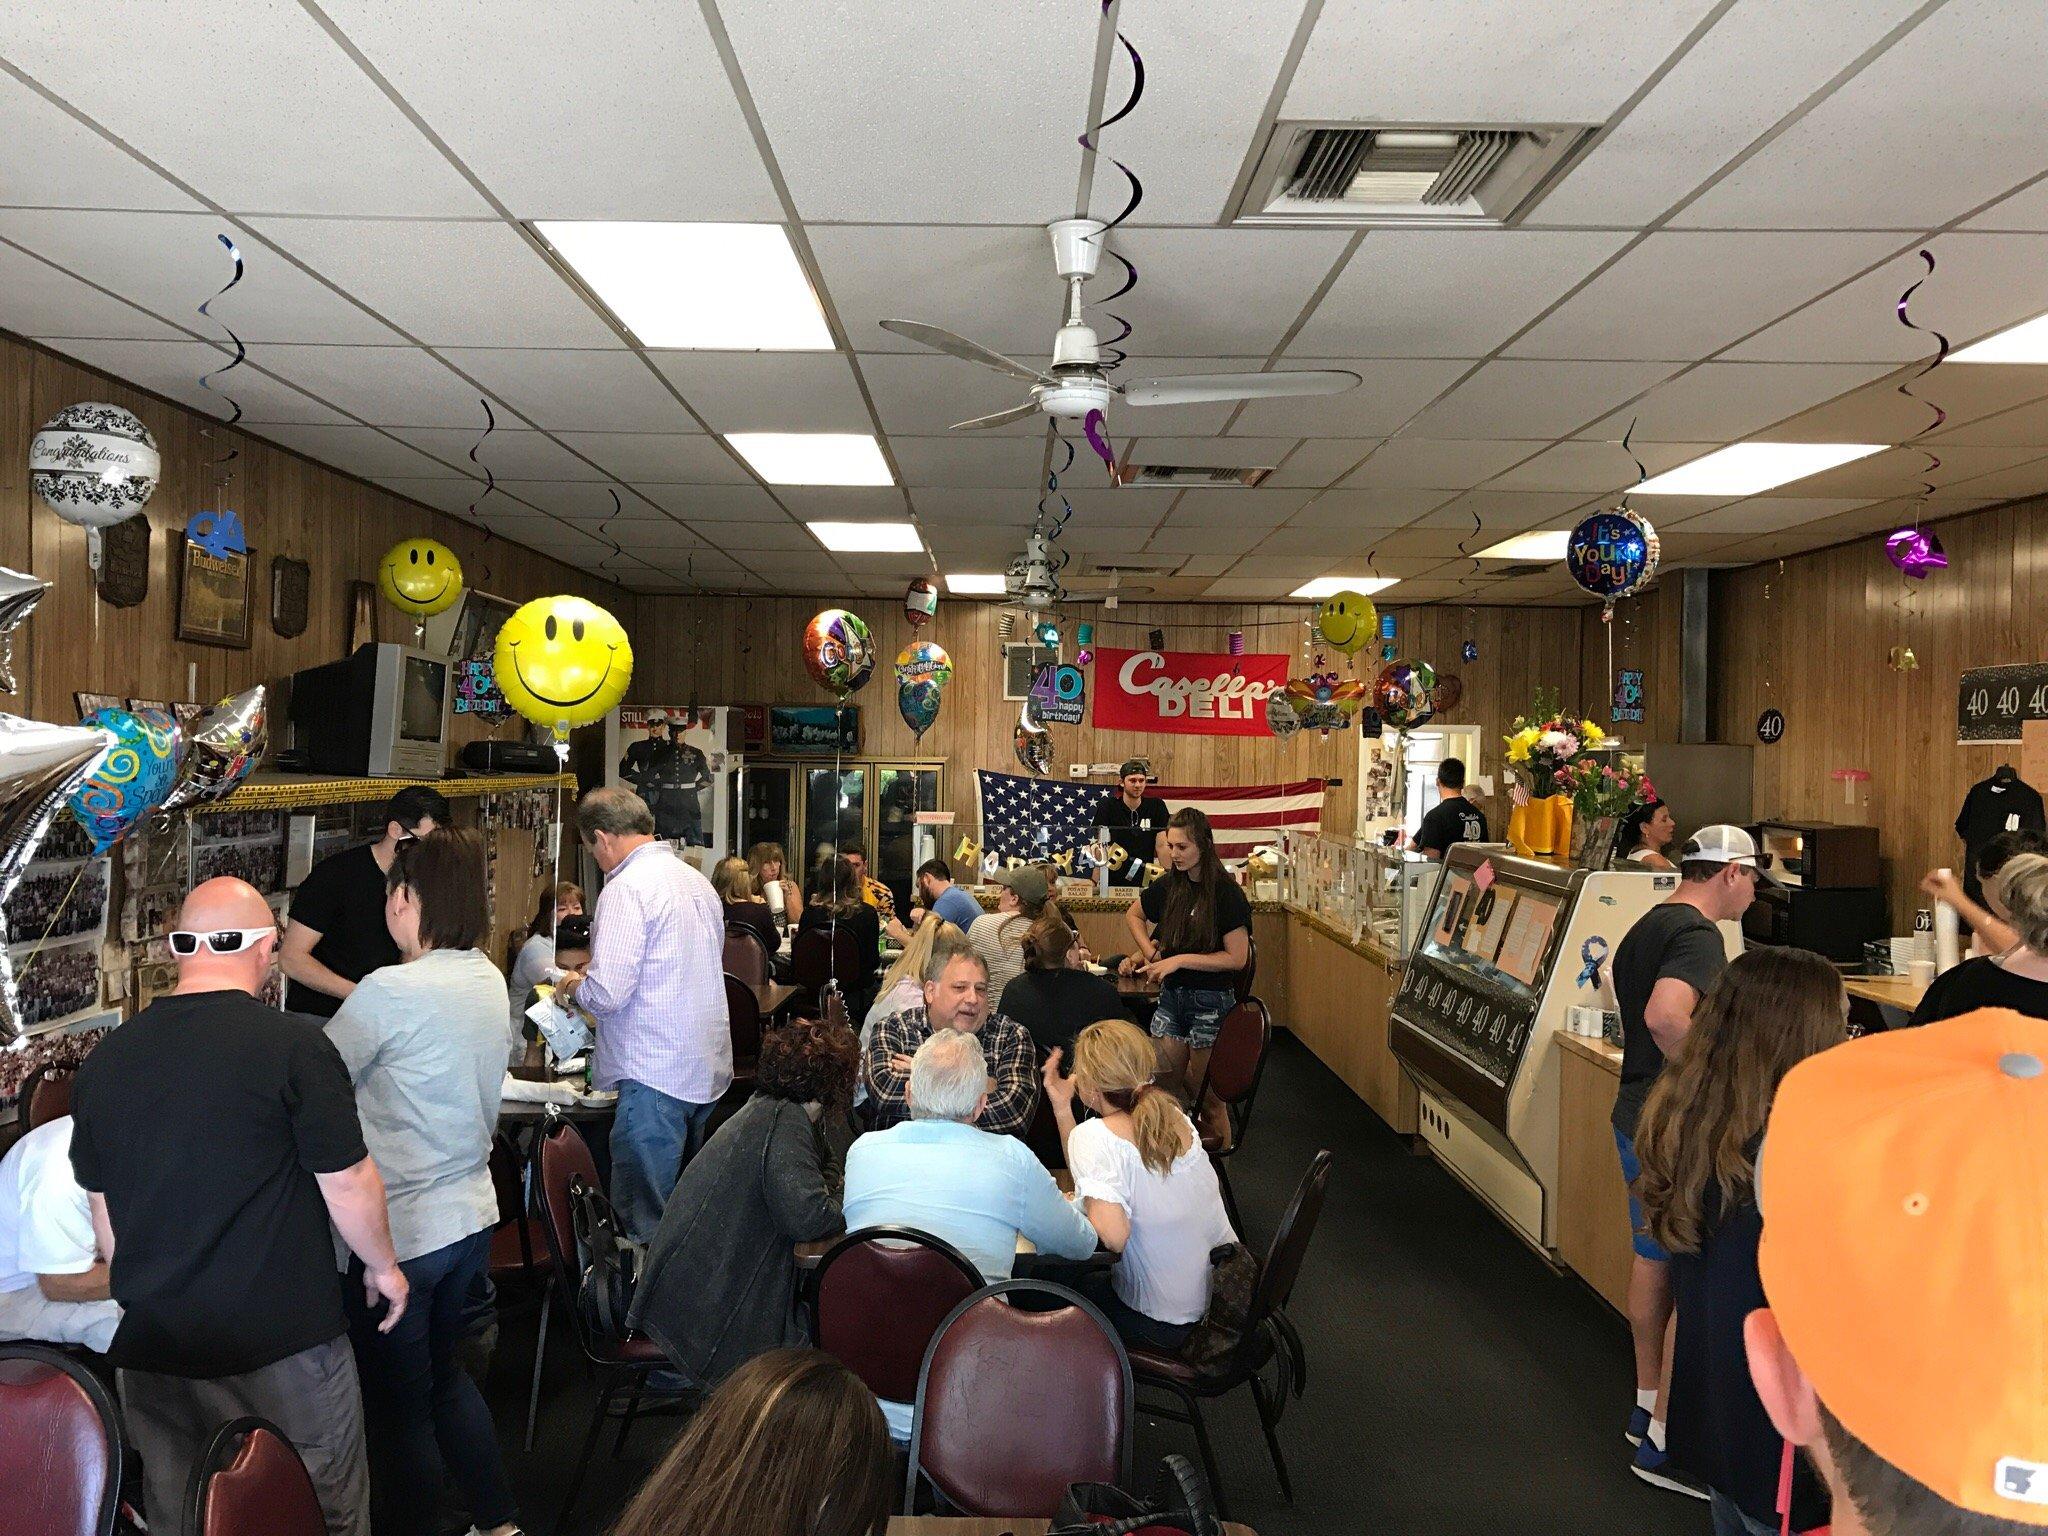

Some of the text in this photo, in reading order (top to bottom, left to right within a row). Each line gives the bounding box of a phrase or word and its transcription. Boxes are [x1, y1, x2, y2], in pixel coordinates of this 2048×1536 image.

[193, 549, 241, 578] Budweiser
[1030, 665, 1083, 710] 40
[1966, 688, 1989, 716] 40
[1996, 686, 2020, 715] 40
[1041, 711, 1081, 722] birthday!
[1059, 702, 1083, 712] happy
[1158, 692, 1254, 719] DELI
[1760, 716, 1782, 736] 40
[1463, 820, 1481, 840] 40
[1400, 968, 1415, 993] 0
[1413, 973, 1429, 1000] 40
[1427, 980, 1443, 1008] 40
[1441, 987, 1457, 1016] 40
[1456, 994, 1473, 1025] 40
[1472, 1002, 1489, 1034] 40
[1488, 1010, 1507, 1043] 40
